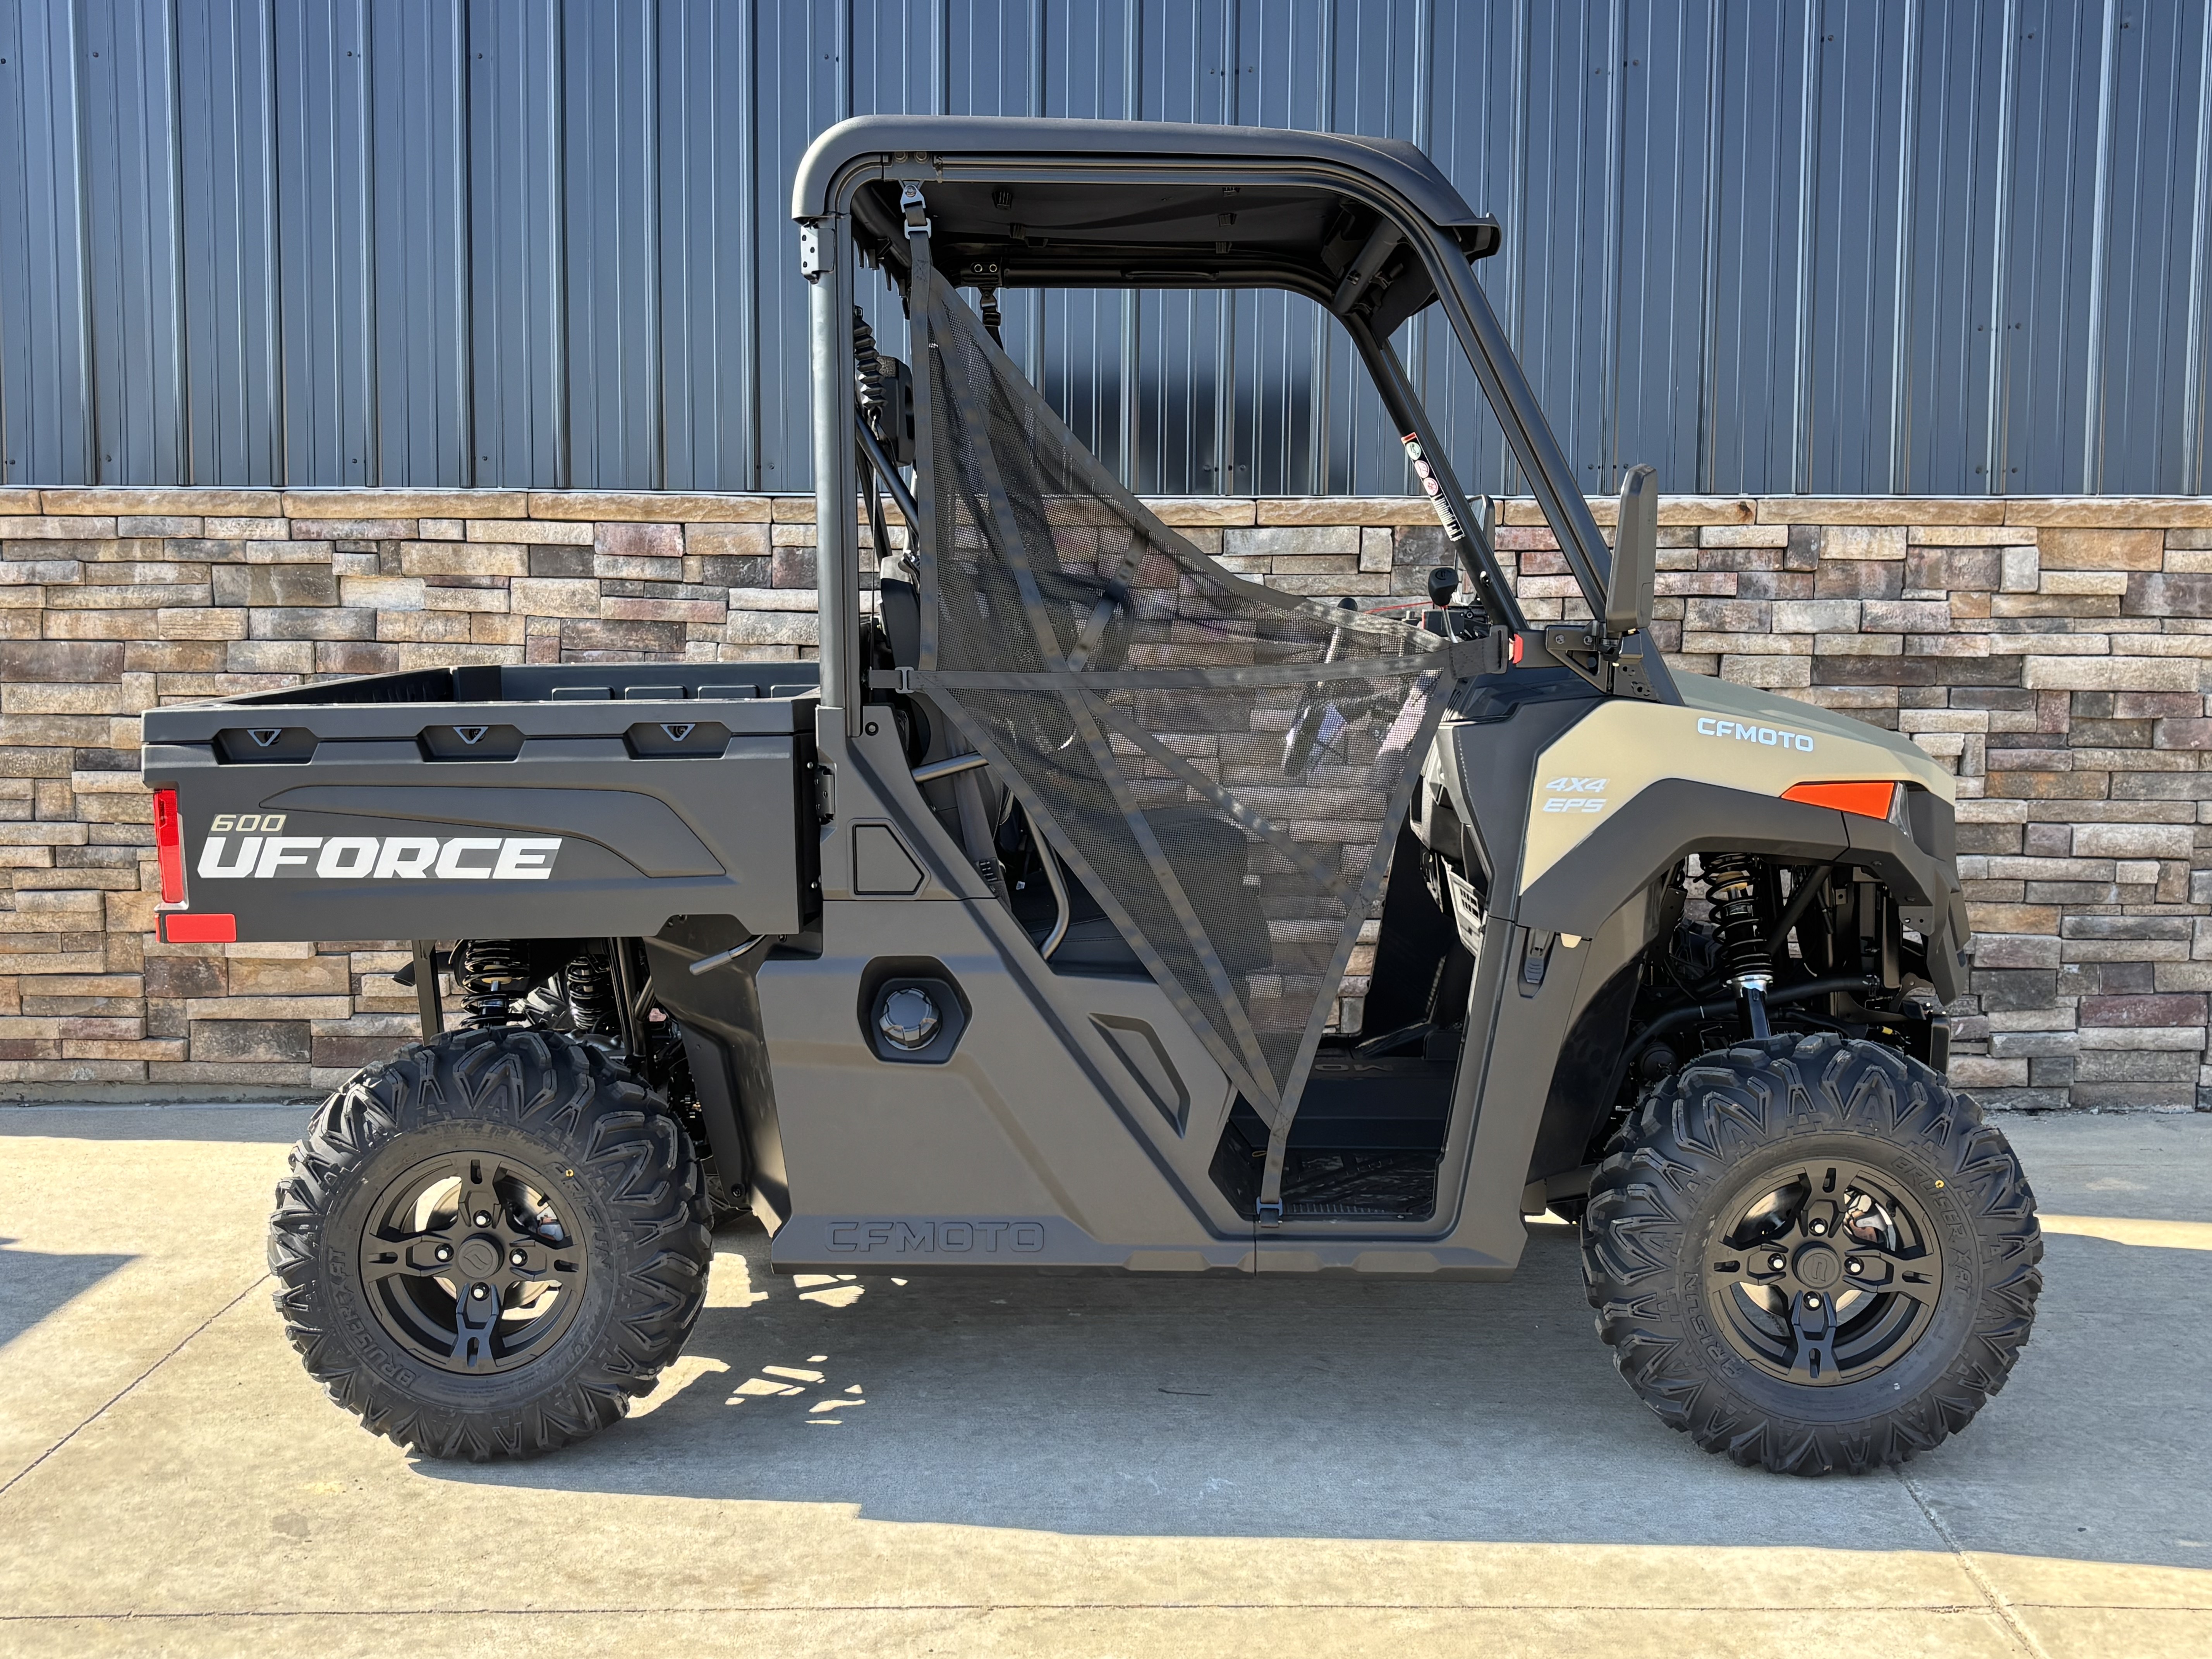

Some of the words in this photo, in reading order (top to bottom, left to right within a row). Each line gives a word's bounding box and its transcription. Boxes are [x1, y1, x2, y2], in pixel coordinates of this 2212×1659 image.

[1697, 717, 1814, 752] CFMOTO
[1546, 777, 1607, 792] 4X4
[1543, 798, 1607, 812] EPS
[212, 814, 286, 832] 600
[197, 836, 562, 879] UFORCE
[1891, 1156, 1967, 1242] BRUISER
[825, 1222, 1044, 1252] CFMOTO
[1684, 1272, 1745, 1379] ARISUN
[338, 1305, 417, 1389] BRUISER
